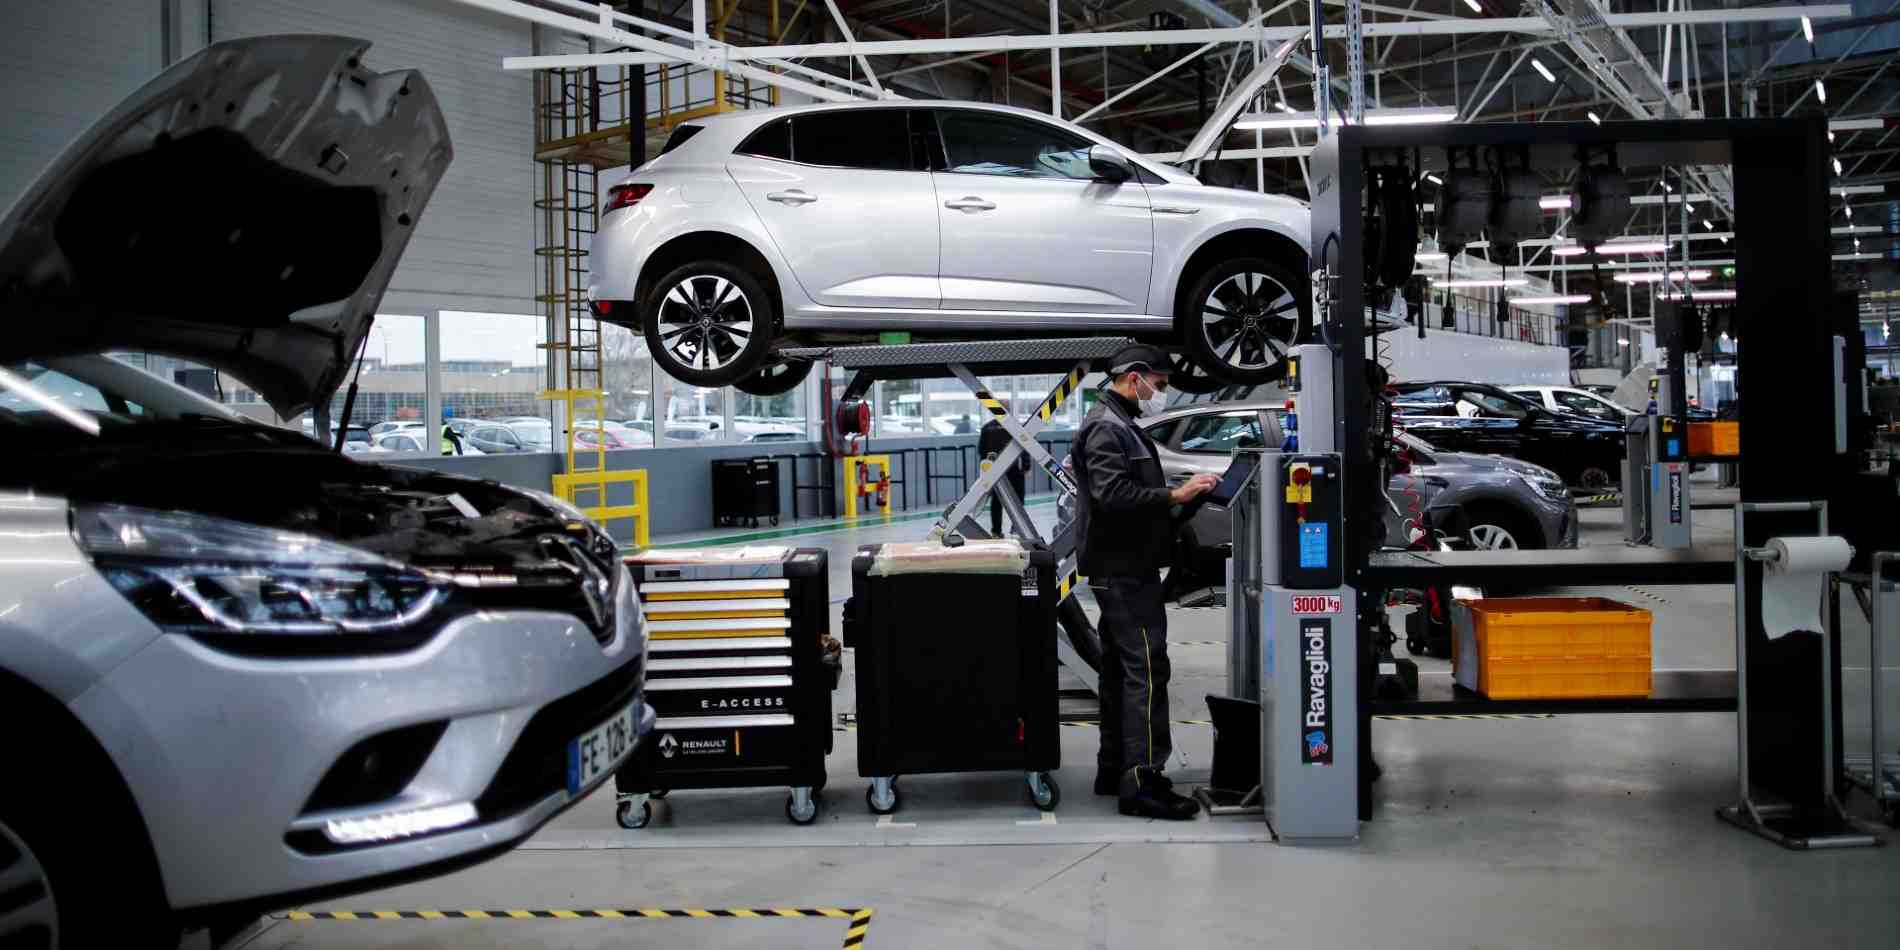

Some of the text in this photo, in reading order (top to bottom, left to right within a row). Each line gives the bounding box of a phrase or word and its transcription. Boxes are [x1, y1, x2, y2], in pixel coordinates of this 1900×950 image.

[1295, 597, 1340, 612] 3000 kg
[1305, 627, 1329, 727] Ravaglioli
[701, 698, 784, 708] E-ACCESS
[682, 740, 727, 749] RENAULT
